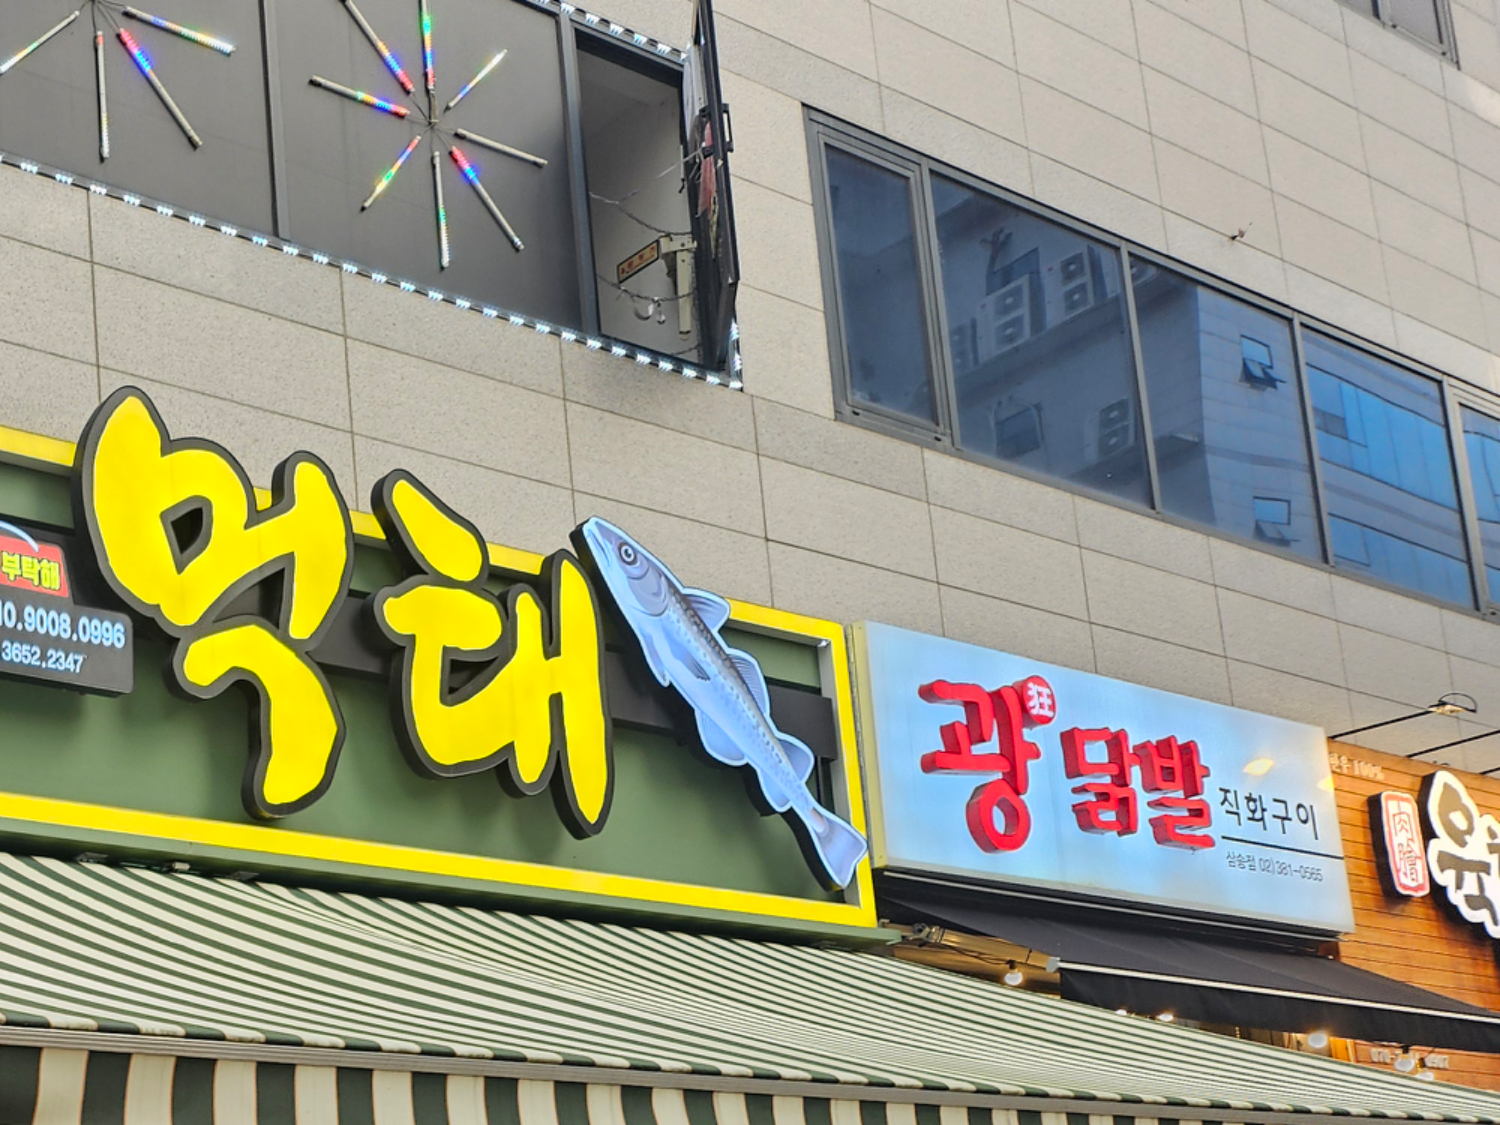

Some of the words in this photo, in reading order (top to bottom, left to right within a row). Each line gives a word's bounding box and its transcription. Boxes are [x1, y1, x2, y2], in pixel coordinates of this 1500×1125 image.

[1, 551, 60, 590] 부탁해
[92, 394, 608, 831] 먹태
[919, 678, 1041, 852] 광
[1061, 727, 1216, 850] 닭발
[1219, 787, 1318, 840] 직화구이
[1437, 781, 1500, 926] 육
